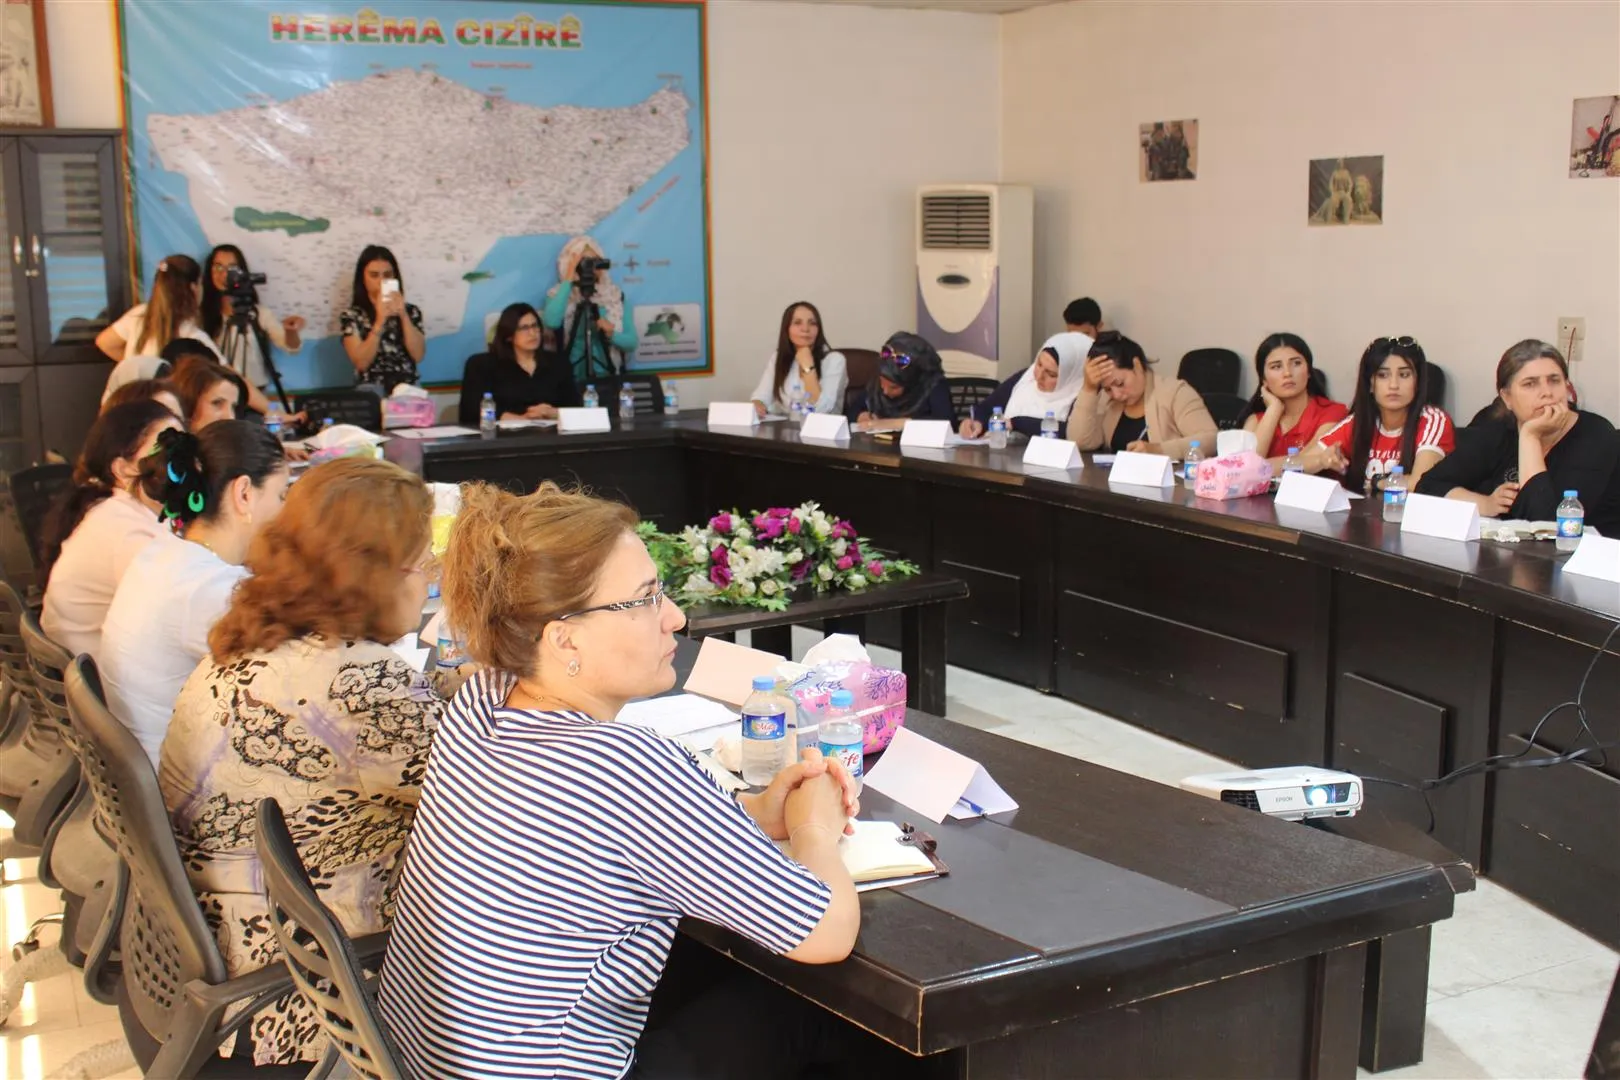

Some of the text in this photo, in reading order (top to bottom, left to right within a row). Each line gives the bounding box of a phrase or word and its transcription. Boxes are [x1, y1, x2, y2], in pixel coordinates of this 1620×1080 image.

[270, 8, 582, 48] HERÊMA CIZÎRÊ
[1275, 795, 1293, 803] EPSON
